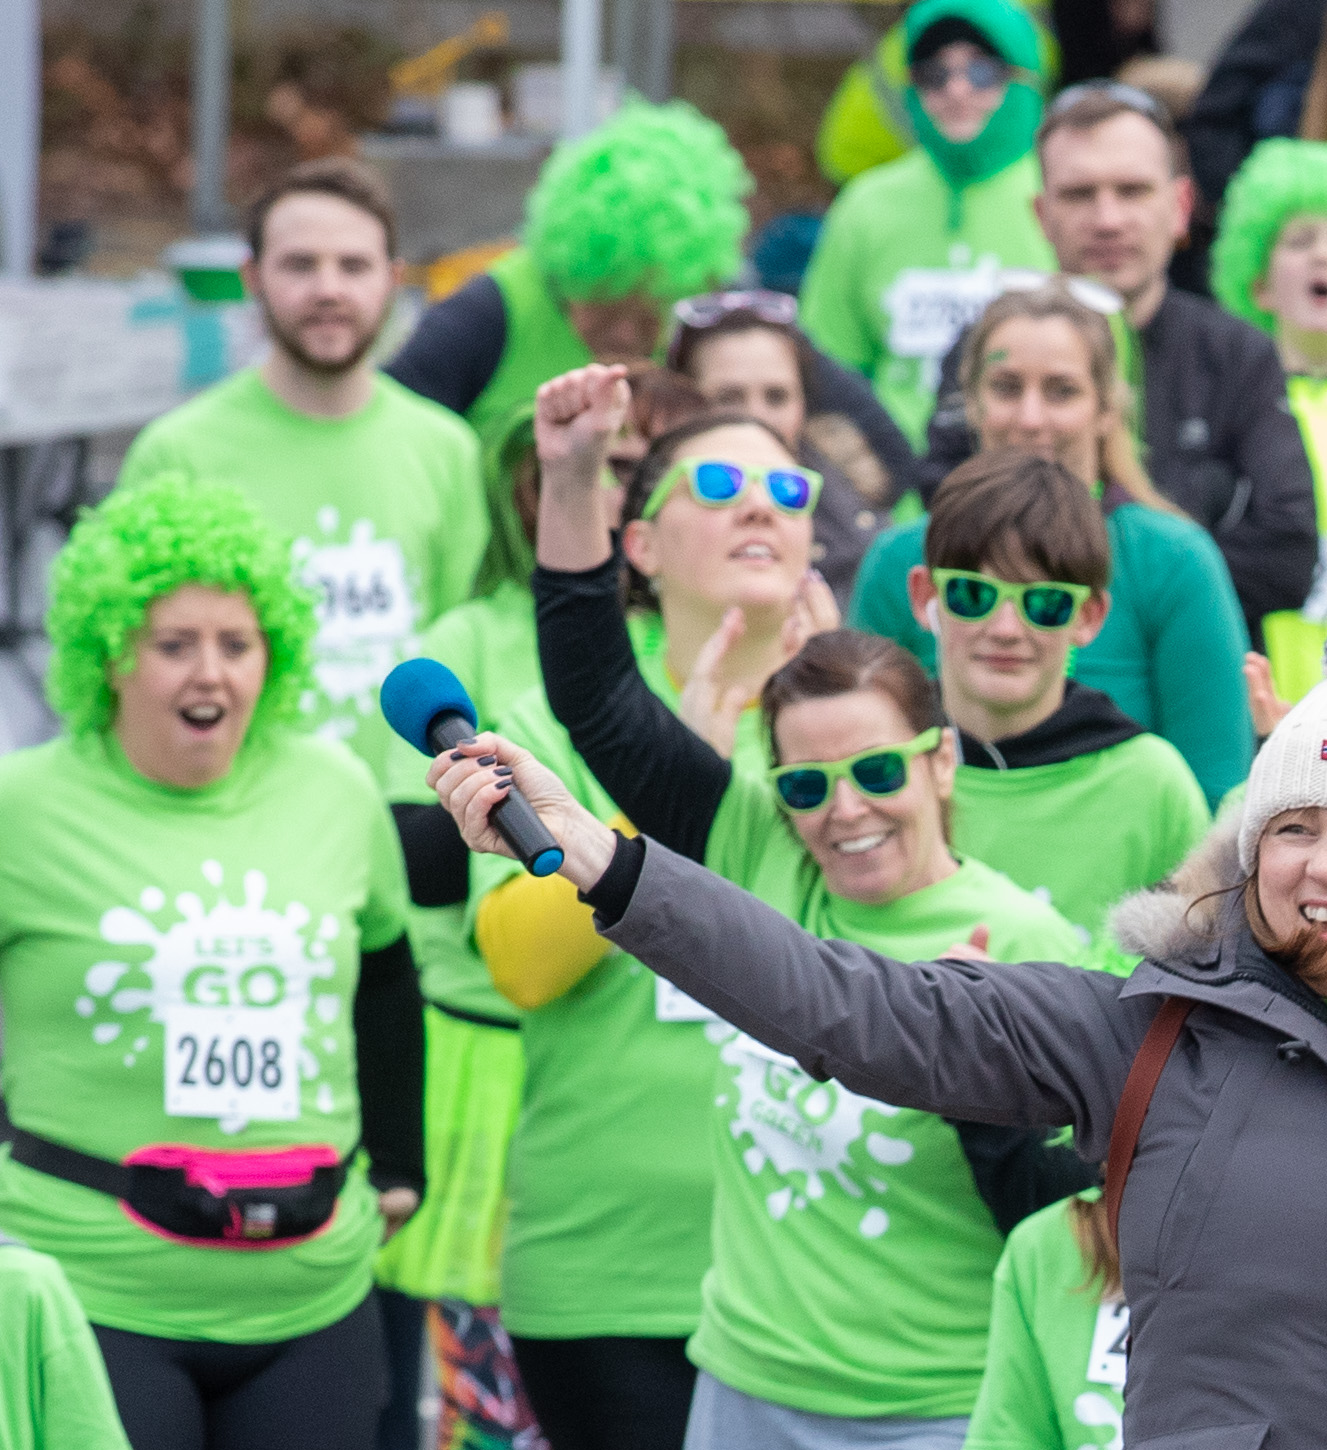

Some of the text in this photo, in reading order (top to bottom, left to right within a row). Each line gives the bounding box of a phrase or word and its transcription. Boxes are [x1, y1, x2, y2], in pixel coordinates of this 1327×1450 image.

[195, 937, 274, 956] LET'S
[182, 964, 287, 1009] GO
[177, 1033, 283, 1089] 2608
